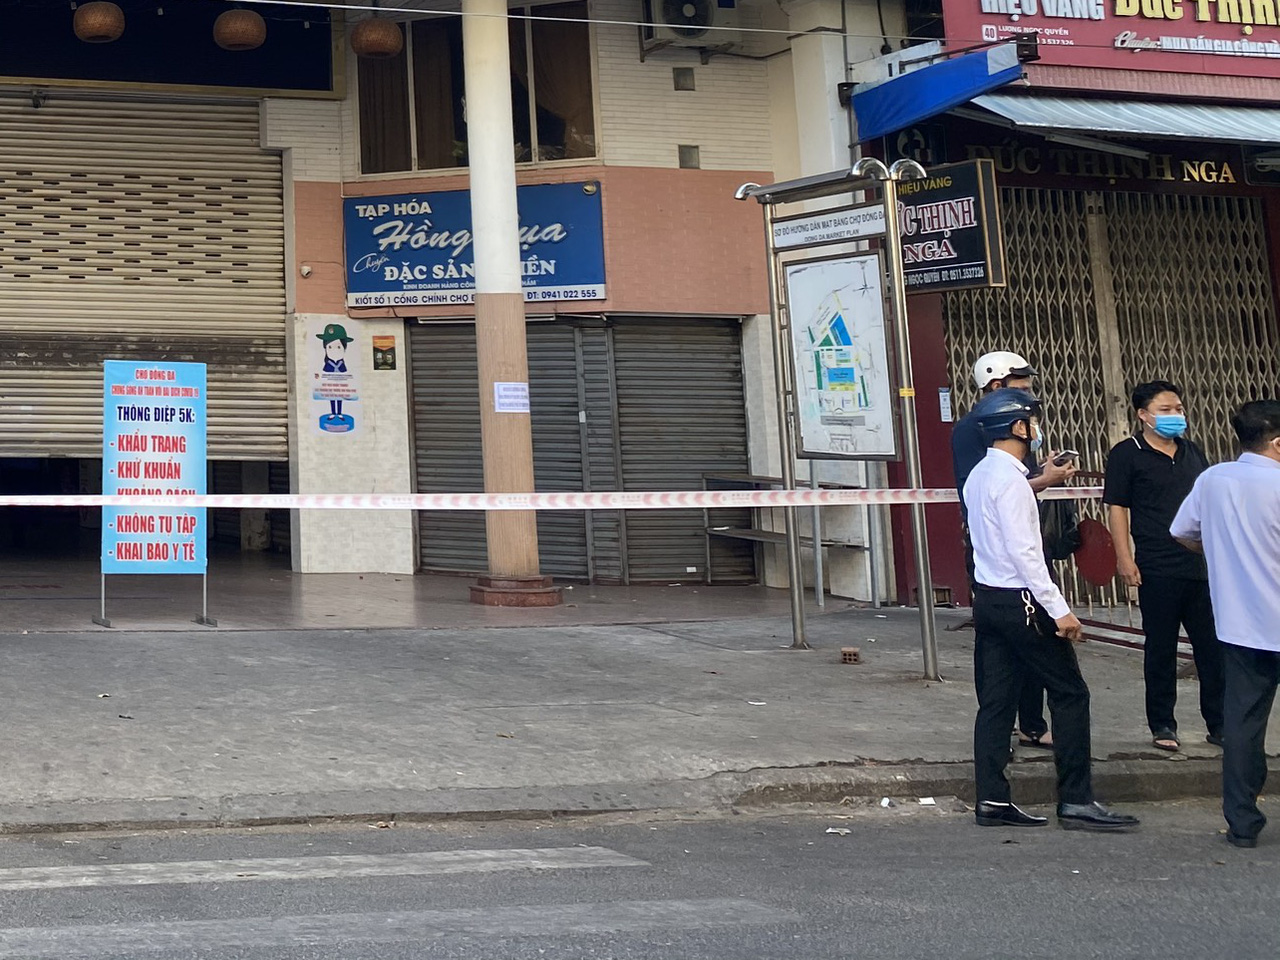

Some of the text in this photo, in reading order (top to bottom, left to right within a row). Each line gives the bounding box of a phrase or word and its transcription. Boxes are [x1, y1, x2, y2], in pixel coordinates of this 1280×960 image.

[984, 28, 995, 39] 40
[1180, 160, 1237, 184] NGA
[898, 176, 952, 195] HIỆU VÀNG
[355, 198, 432, 221] TẠP HÓA
[917, 196, 978, 238] THỊNH
[373, 219, 567, 257] Hồng ụa
[826, 230, 845, 240] MARKET
[846, 229, 860, 237] PLAN
[903, 239, 957, 264] NGA
[384, 254, 556, 283] ĐẶC SẢN IỀN
[460, 280, 476, 288] CÔN
[374, 292, 385, 304] SỐ
[421, 292, 448, 303] CHÍNH
[450, 293, 469, 303] CHỢ
[541, 290, 560, 298] 0941
[563, 290, 578, 298] 022
[581, 289, 597, 298] 555
[117, 403, 195, 425] THÔNG ĐIỆP 5K:
[117, 428, 186, 453] KHẨU TRANG
[116, 512, 155, 533] KHÔNG
[176, 513, 196, 537] TẬP
[116, 542, 143, 560] KHAI
[147, 540, 169, 560] BÁO
[172, 543, 179, 560] Y
